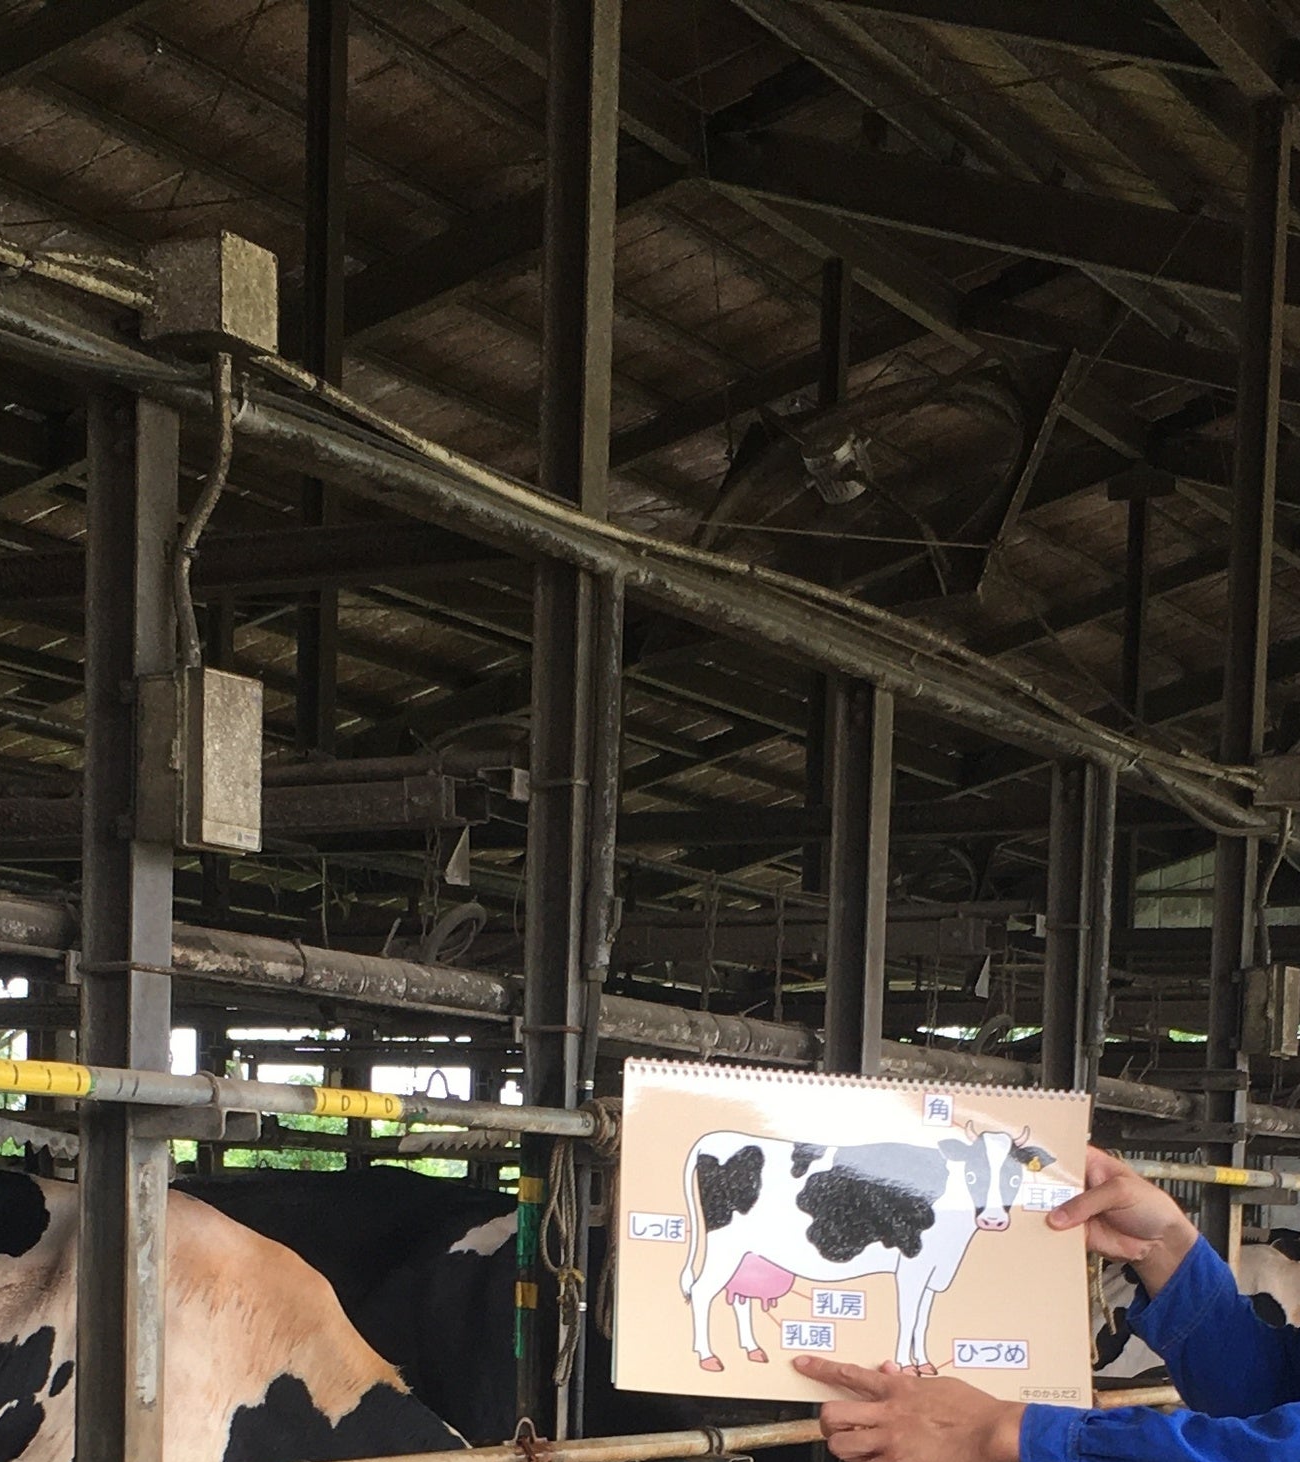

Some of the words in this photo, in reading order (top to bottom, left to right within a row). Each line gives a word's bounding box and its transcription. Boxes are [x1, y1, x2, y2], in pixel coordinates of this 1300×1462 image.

[928, 1098, 949, 1121] 角
[632, 1215, 684, 1239] しっぽ
[816, 1292, 862, 1316] 乳房
[785, 1324, 832, 1348] 乳頭
[957, 1344, 1026, 1364] ひづめ
